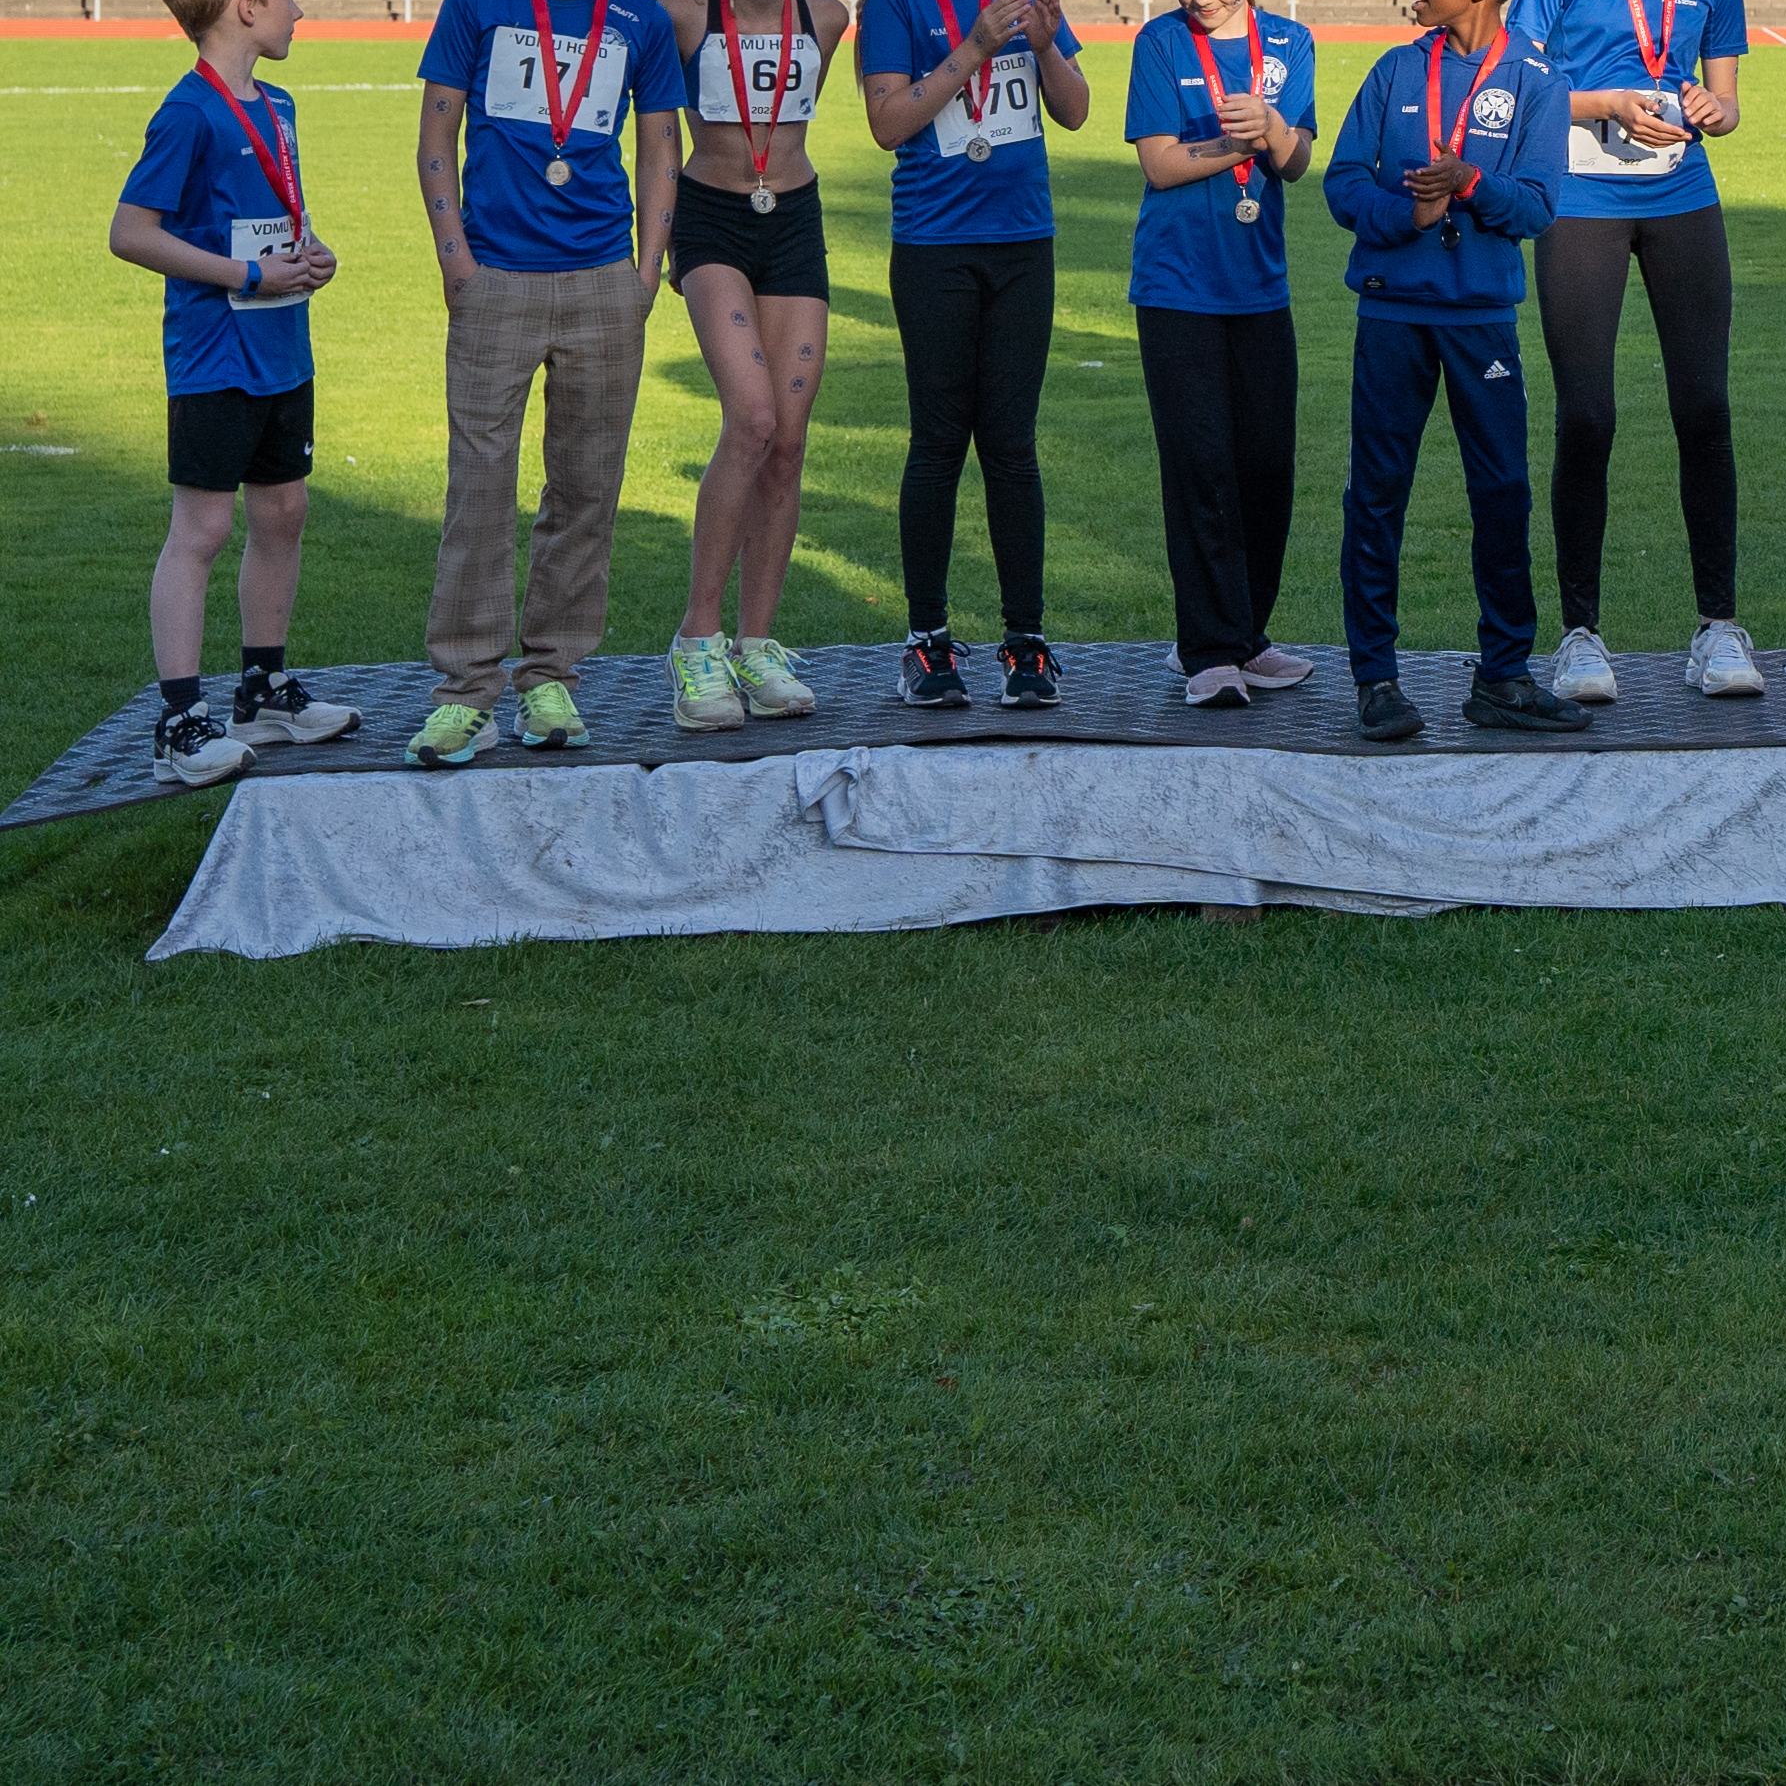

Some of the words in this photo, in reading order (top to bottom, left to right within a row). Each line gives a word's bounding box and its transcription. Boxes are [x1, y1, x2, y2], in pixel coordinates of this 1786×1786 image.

[609, 3, 633, 19] CRAFT
[514, 33, 562, 51] VDU
[566, 41, 608, 59] HOD
[719, 38, 765, 50] VMU
[991, 56, 1026, 73] HOLD
[727, 59, 803, 92] 69
[956, 77, 1029, 120] 170
[990, 127, 1013, 138] 2022
[251, 221, 290, 236] VDMU
[1484, 370, 1511, 380] adidas
